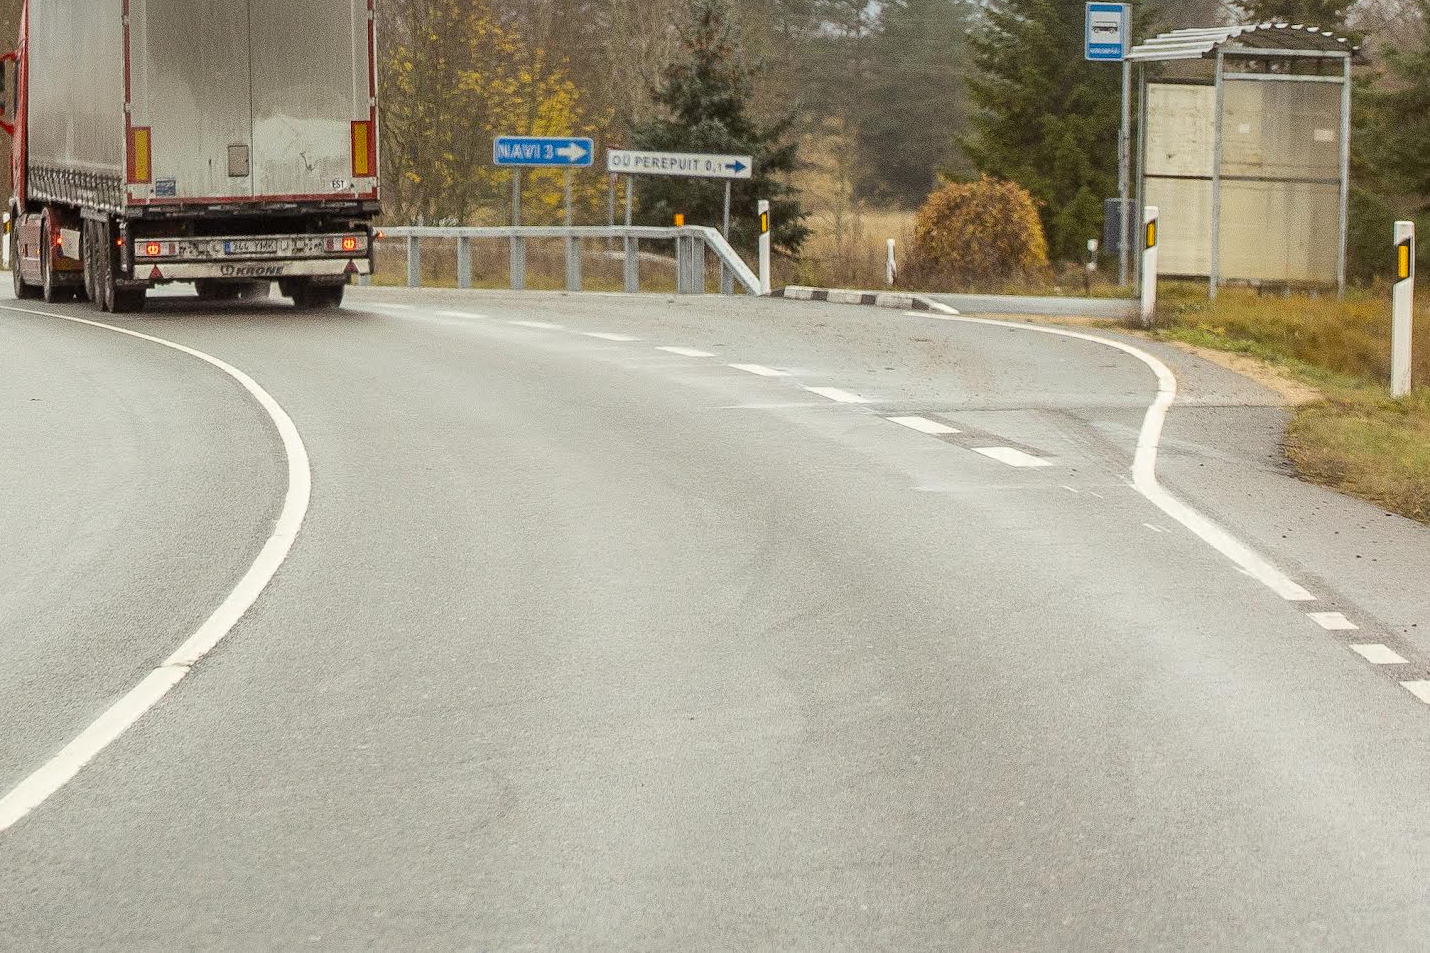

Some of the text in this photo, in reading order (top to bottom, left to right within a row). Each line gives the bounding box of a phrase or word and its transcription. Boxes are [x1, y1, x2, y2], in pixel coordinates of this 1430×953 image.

[498, 144, 554, 160] NAVI 3
[634, 156, 700, 171] PEREPUIT
[236, 266, 285, 276] KRONE
